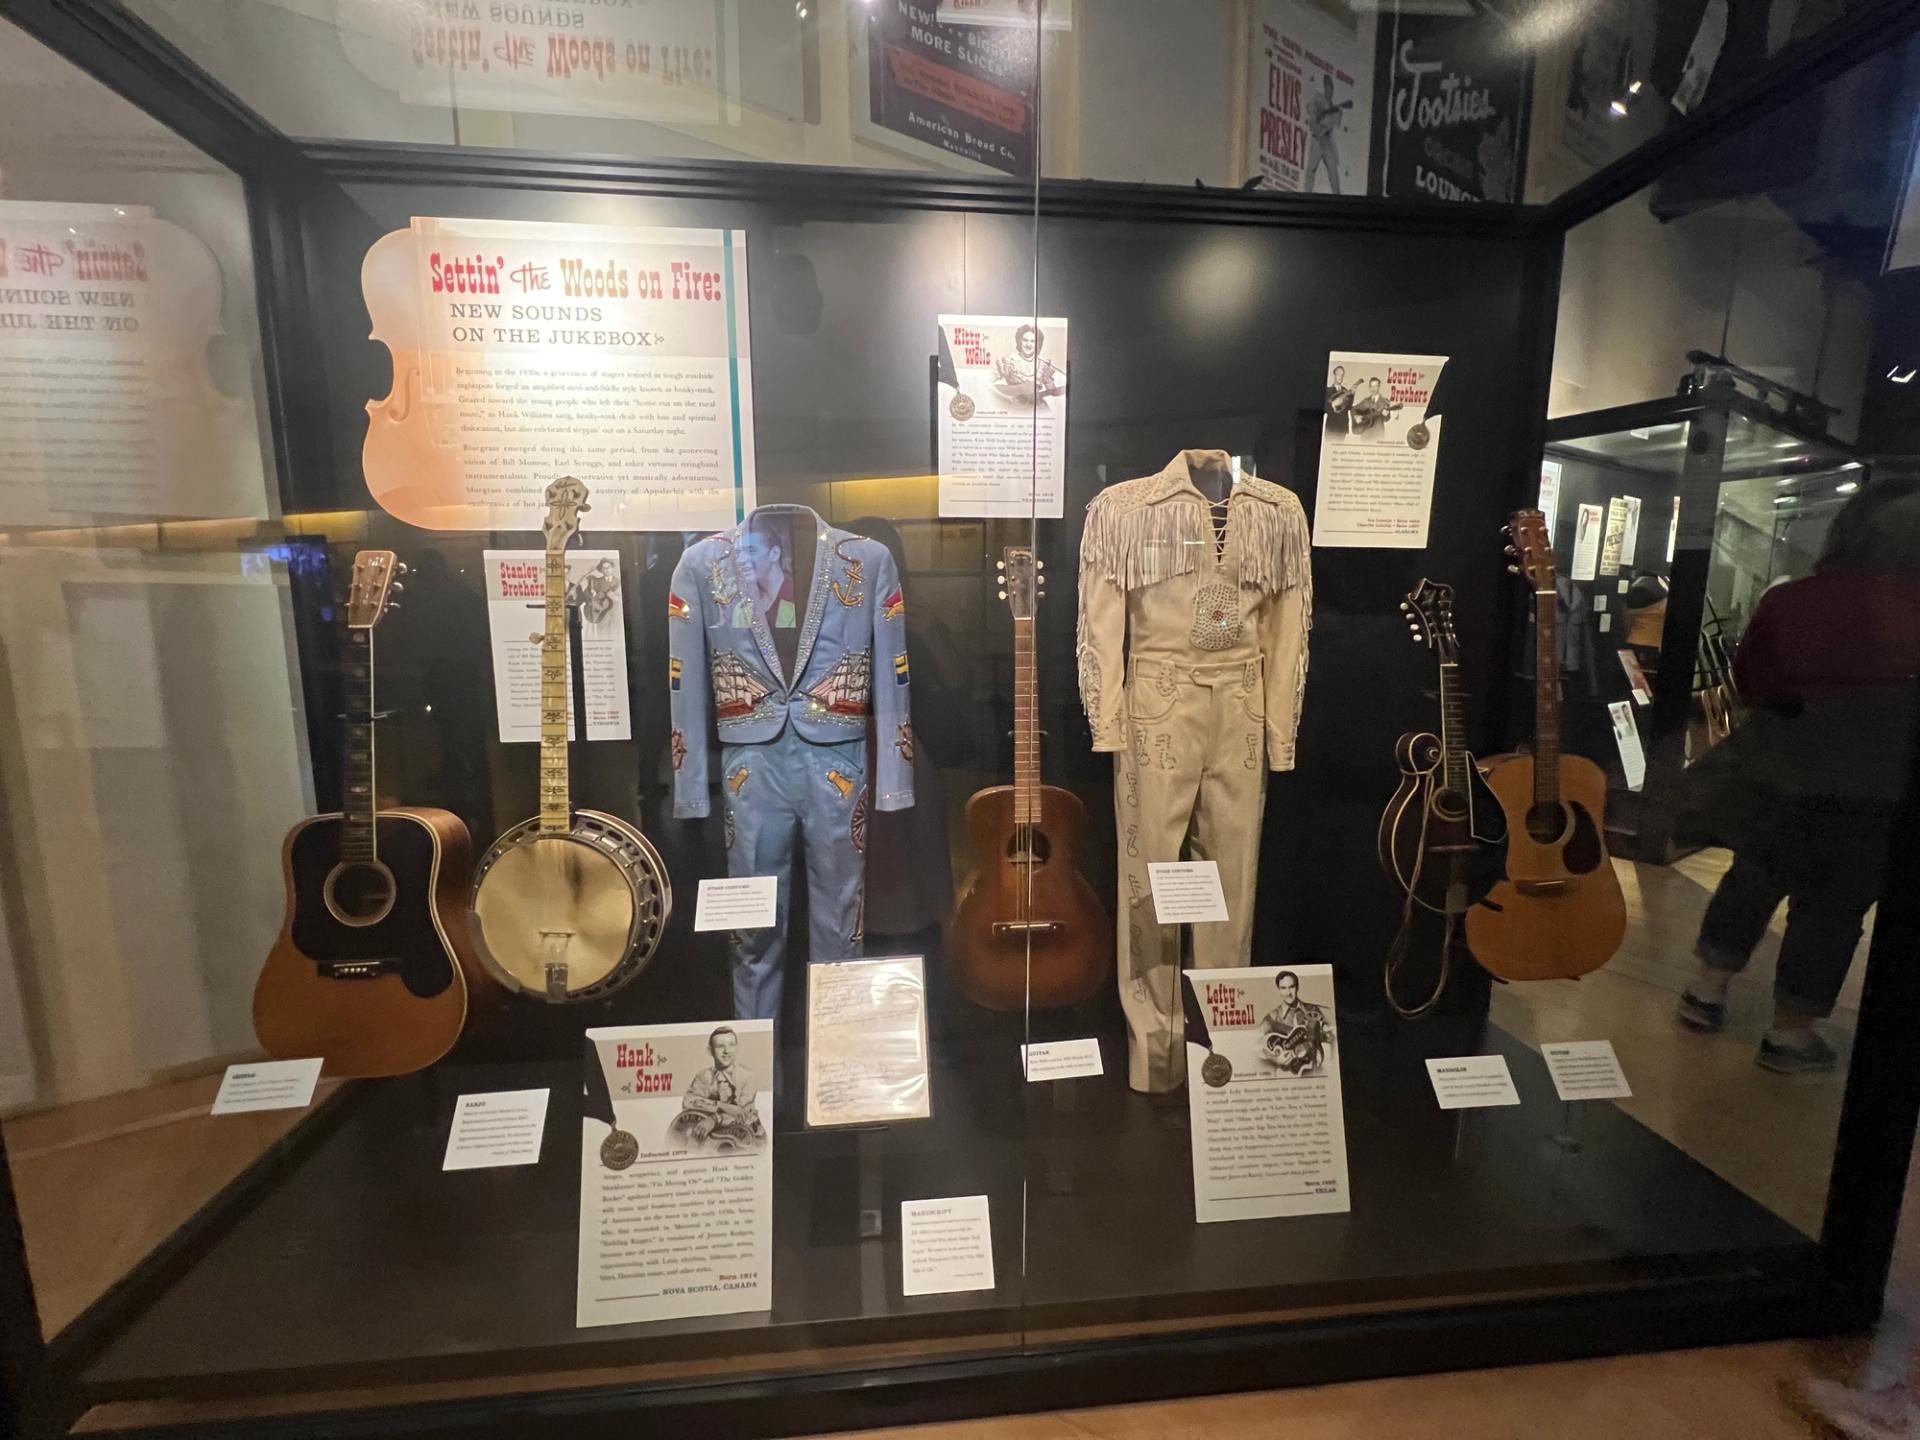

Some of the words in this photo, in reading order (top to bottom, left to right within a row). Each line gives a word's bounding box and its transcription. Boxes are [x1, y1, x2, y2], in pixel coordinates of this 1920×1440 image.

[911, 26, 952, 55] MORE
[1269, 62, 1302, 121] ELVIS
[907, 111, 959, 139] American
[964, 132, 995, 152] Bread
[1260, 107, 1308, 170] PRESLEY
[430, 251, 504, 294] Settin'
[510, 261, 551, 293] the
[560, 258, 629, 298] Woods
[638, 269, 663, 299] on
[671, 261, 721, 301] Fire:
[450, 303, 503, 319] NEW
[512, 305, 603, 321] SOUNDS
[453, 327, 484, 342] ON
[493, 328, 541, 343] THE
[549, 330, 652, 346] JUKEBOX
[1387, 367, 1417, 385] Louvin
[1390, 385, 1428, 403] Brothers
[500, 561, 539, 583] Stanley
[501, 580, 546, 597] Brothers
[1205, 983, 1236, 1008] Lefty
[1212, 1004, 1255, 1026] Frizzell
[616, 1042, 654, 1068] Hank
[636, 1069, 673, 1093] Snow
[662, 1287, 686, 1296] NOVA
[688, 1284, 721, 1294] SCOTIA,
[723, 1281, 757, 1290] CANADA
